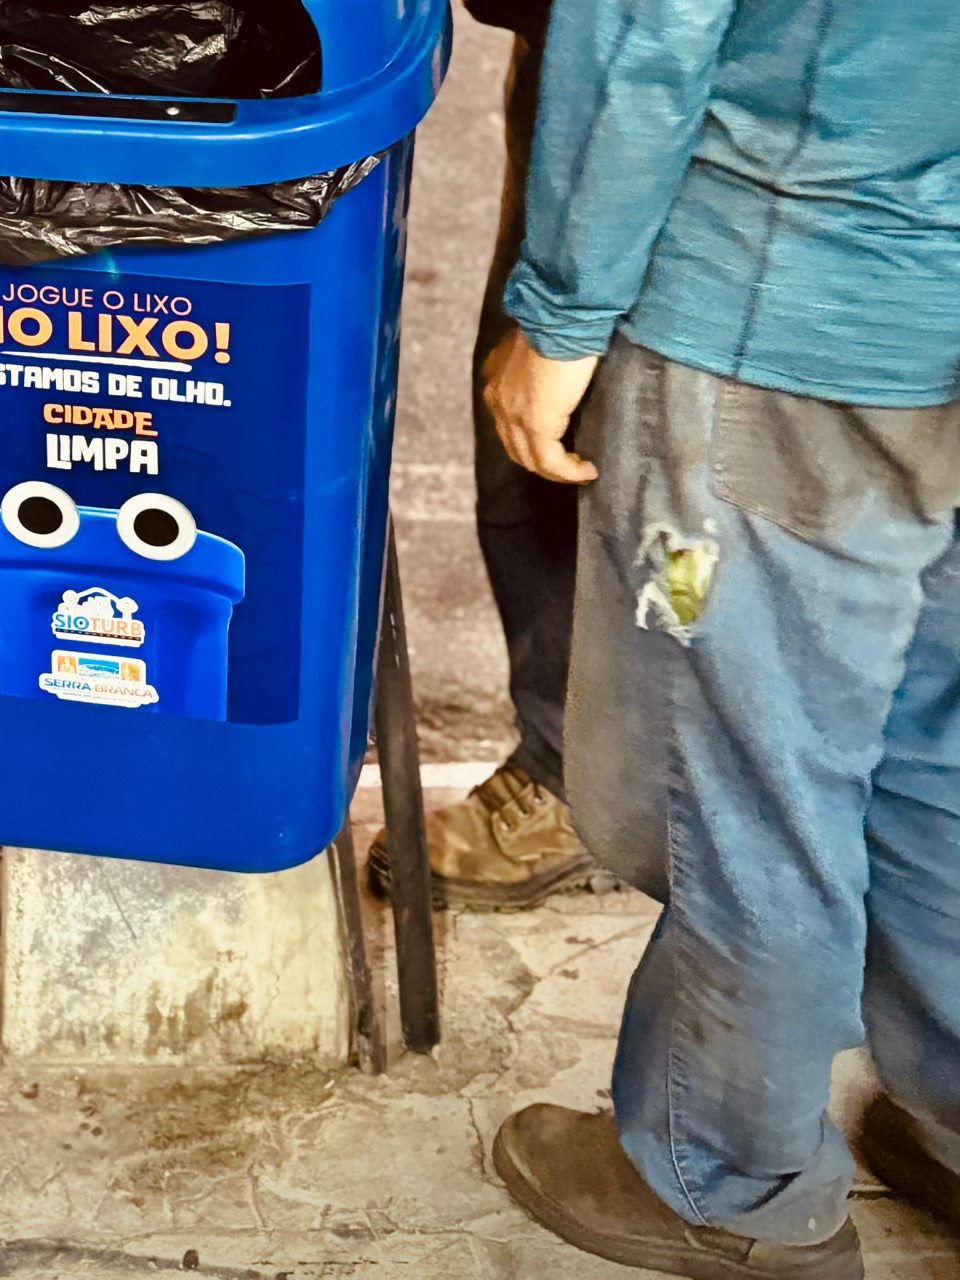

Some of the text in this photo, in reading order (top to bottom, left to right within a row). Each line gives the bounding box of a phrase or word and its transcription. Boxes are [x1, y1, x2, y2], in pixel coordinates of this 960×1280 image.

[2, 283, 192, 316] JOGUE O LIXO
[68, 311, 230, 364] LIXO!
[108, 373, 142, 398] DE
[151, 377, 232, 407] OLHO.
[43, 403, 158, 436] CIDADE
[46, 433, 159, 475] LIMPA
[54, 613, 143, 637] SIOTURB
[44, 677, 92, 692] SERRA
[94, 683, 153, 699] BRANCA
